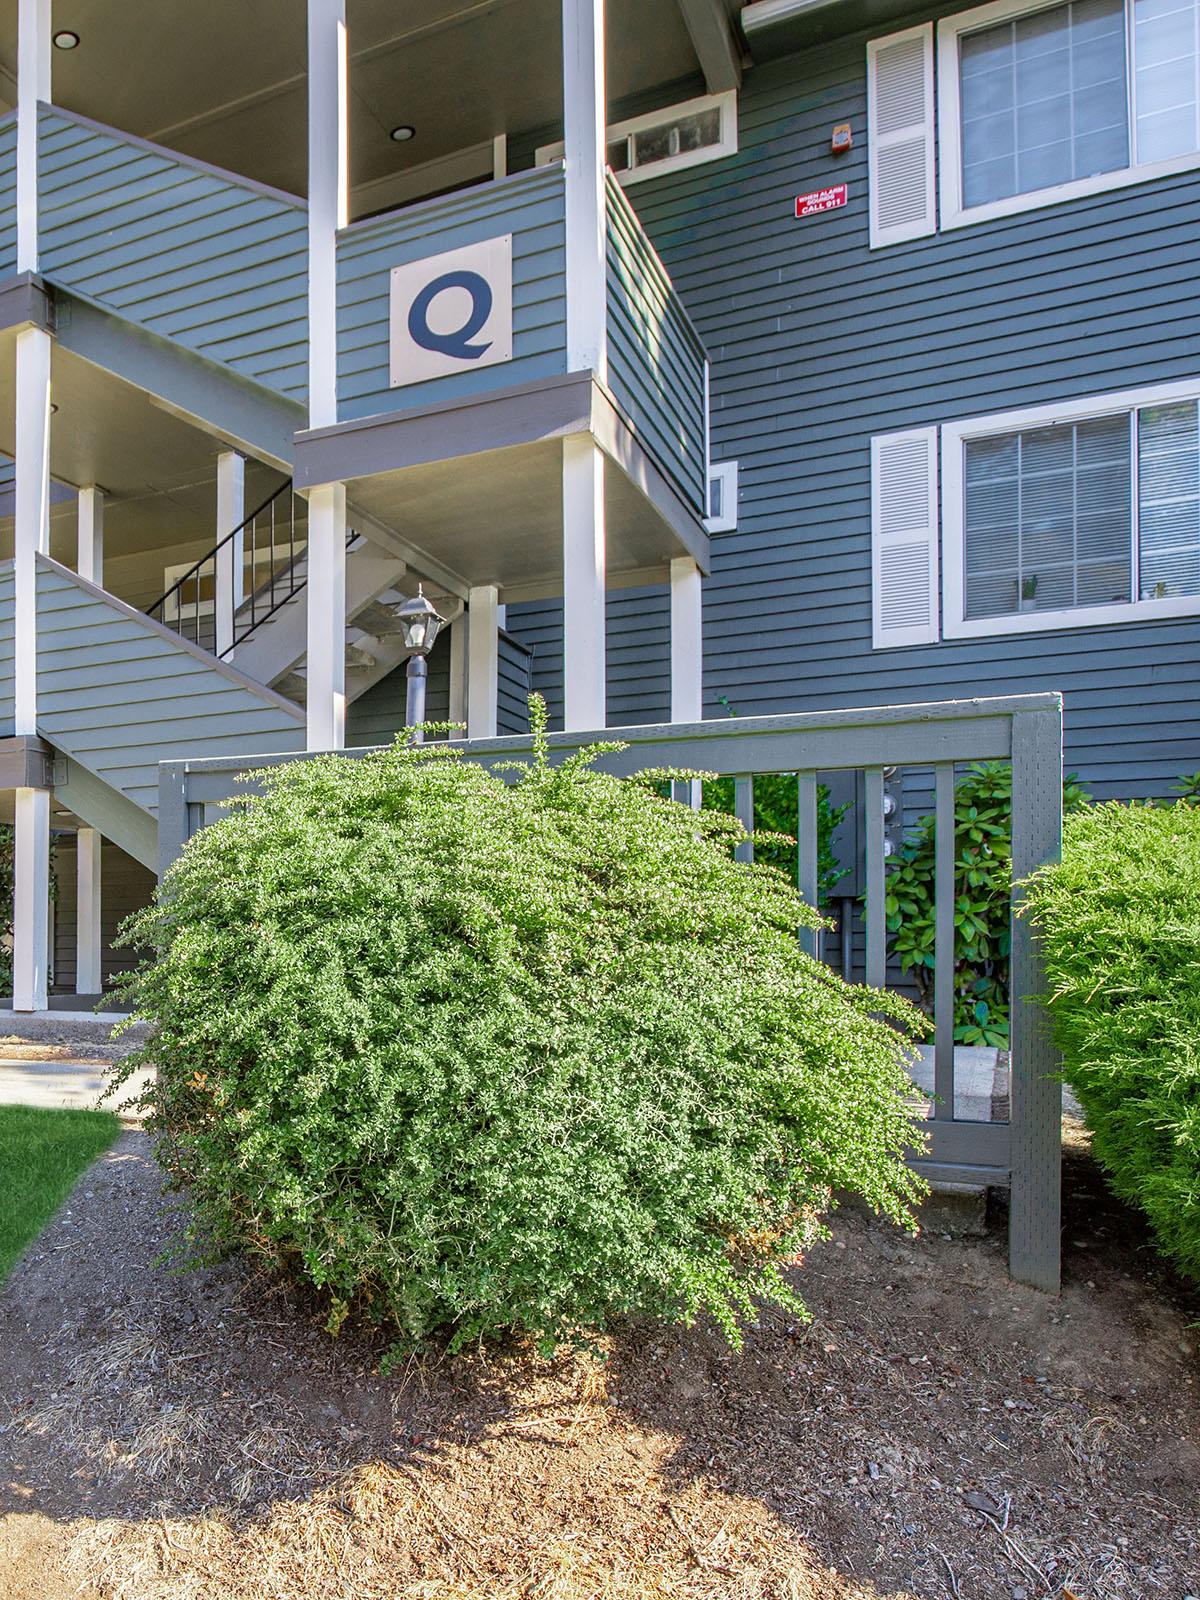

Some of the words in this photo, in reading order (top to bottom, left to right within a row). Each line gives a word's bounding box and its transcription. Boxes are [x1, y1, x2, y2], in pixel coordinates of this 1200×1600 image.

[799, 193, 819, 203] WHEN
[820, 186, 844, 197] ALARM
[801, 203, 825, 214] CALL
[826, 198, 841, 208] 911
[408, 270, 493, 359] Q
